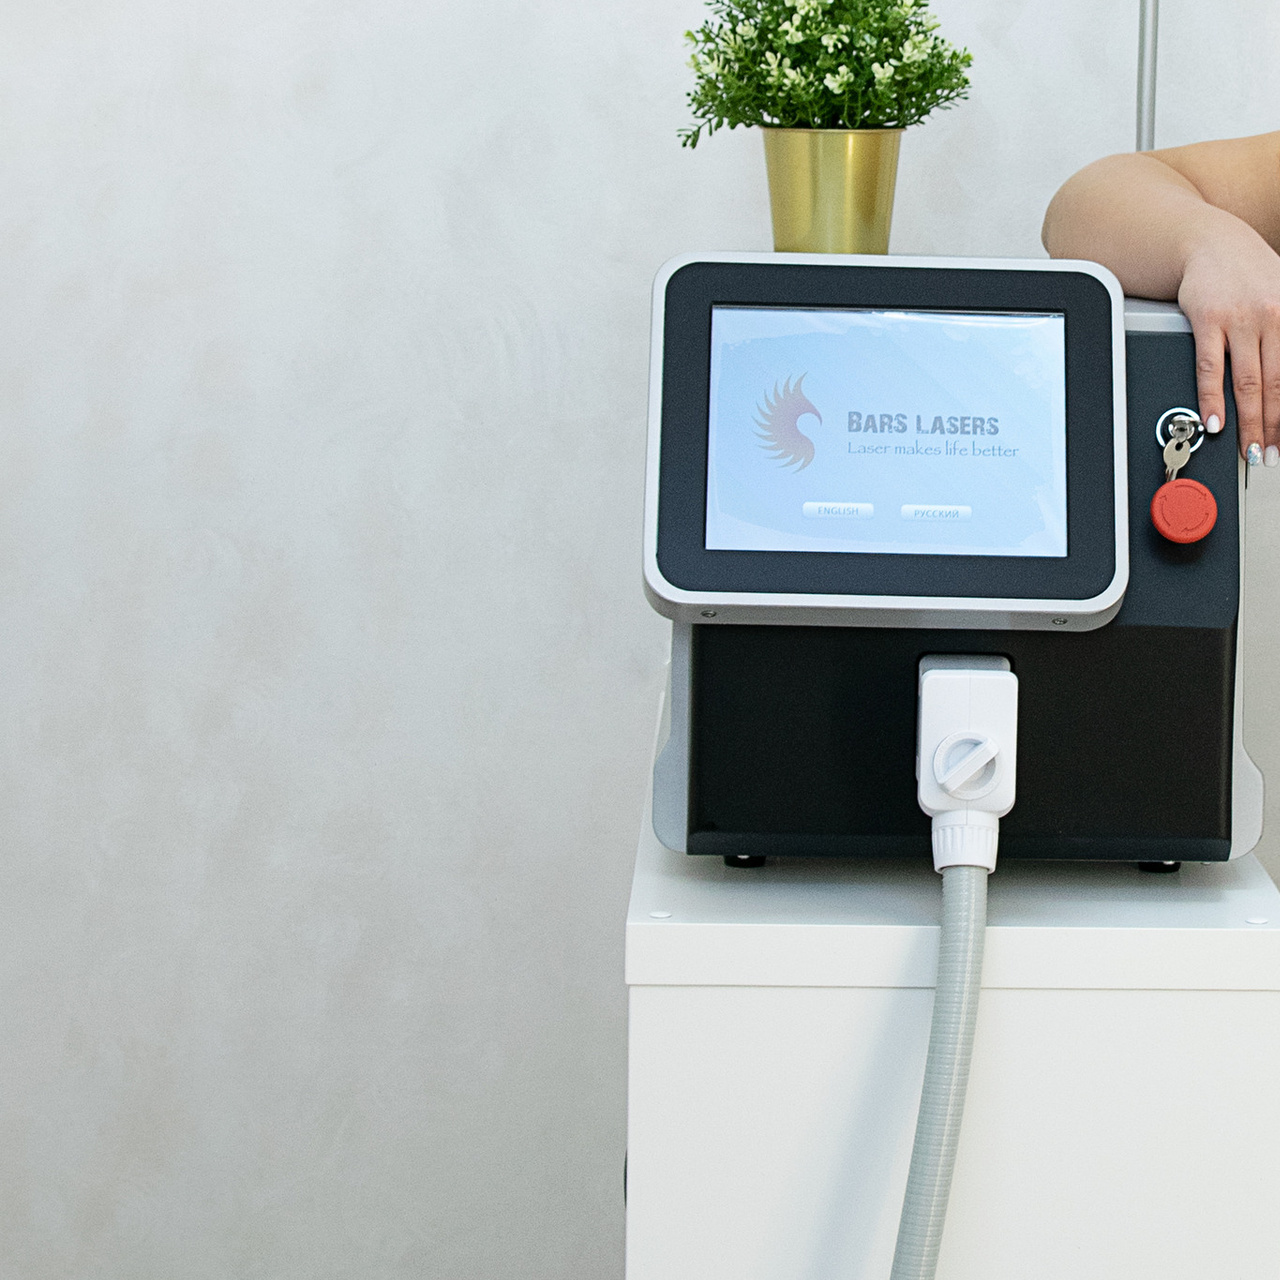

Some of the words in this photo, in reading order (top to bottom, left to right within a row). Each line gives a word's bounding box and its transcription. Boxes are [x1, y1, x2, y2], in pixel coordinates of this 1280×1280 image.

[848, 411, 908, 434] BARS
[916, 414, 999, 436] LASERS
[848, 441, 891, 455] Laser
[894, 440, 942, 456] makes
[945, 440, 968, 456] life
[972, 441, 1019, 458] better
[817, 506, 859, 516] ENGLISH
[914, 508, 960, 519] РУССКИЙ
